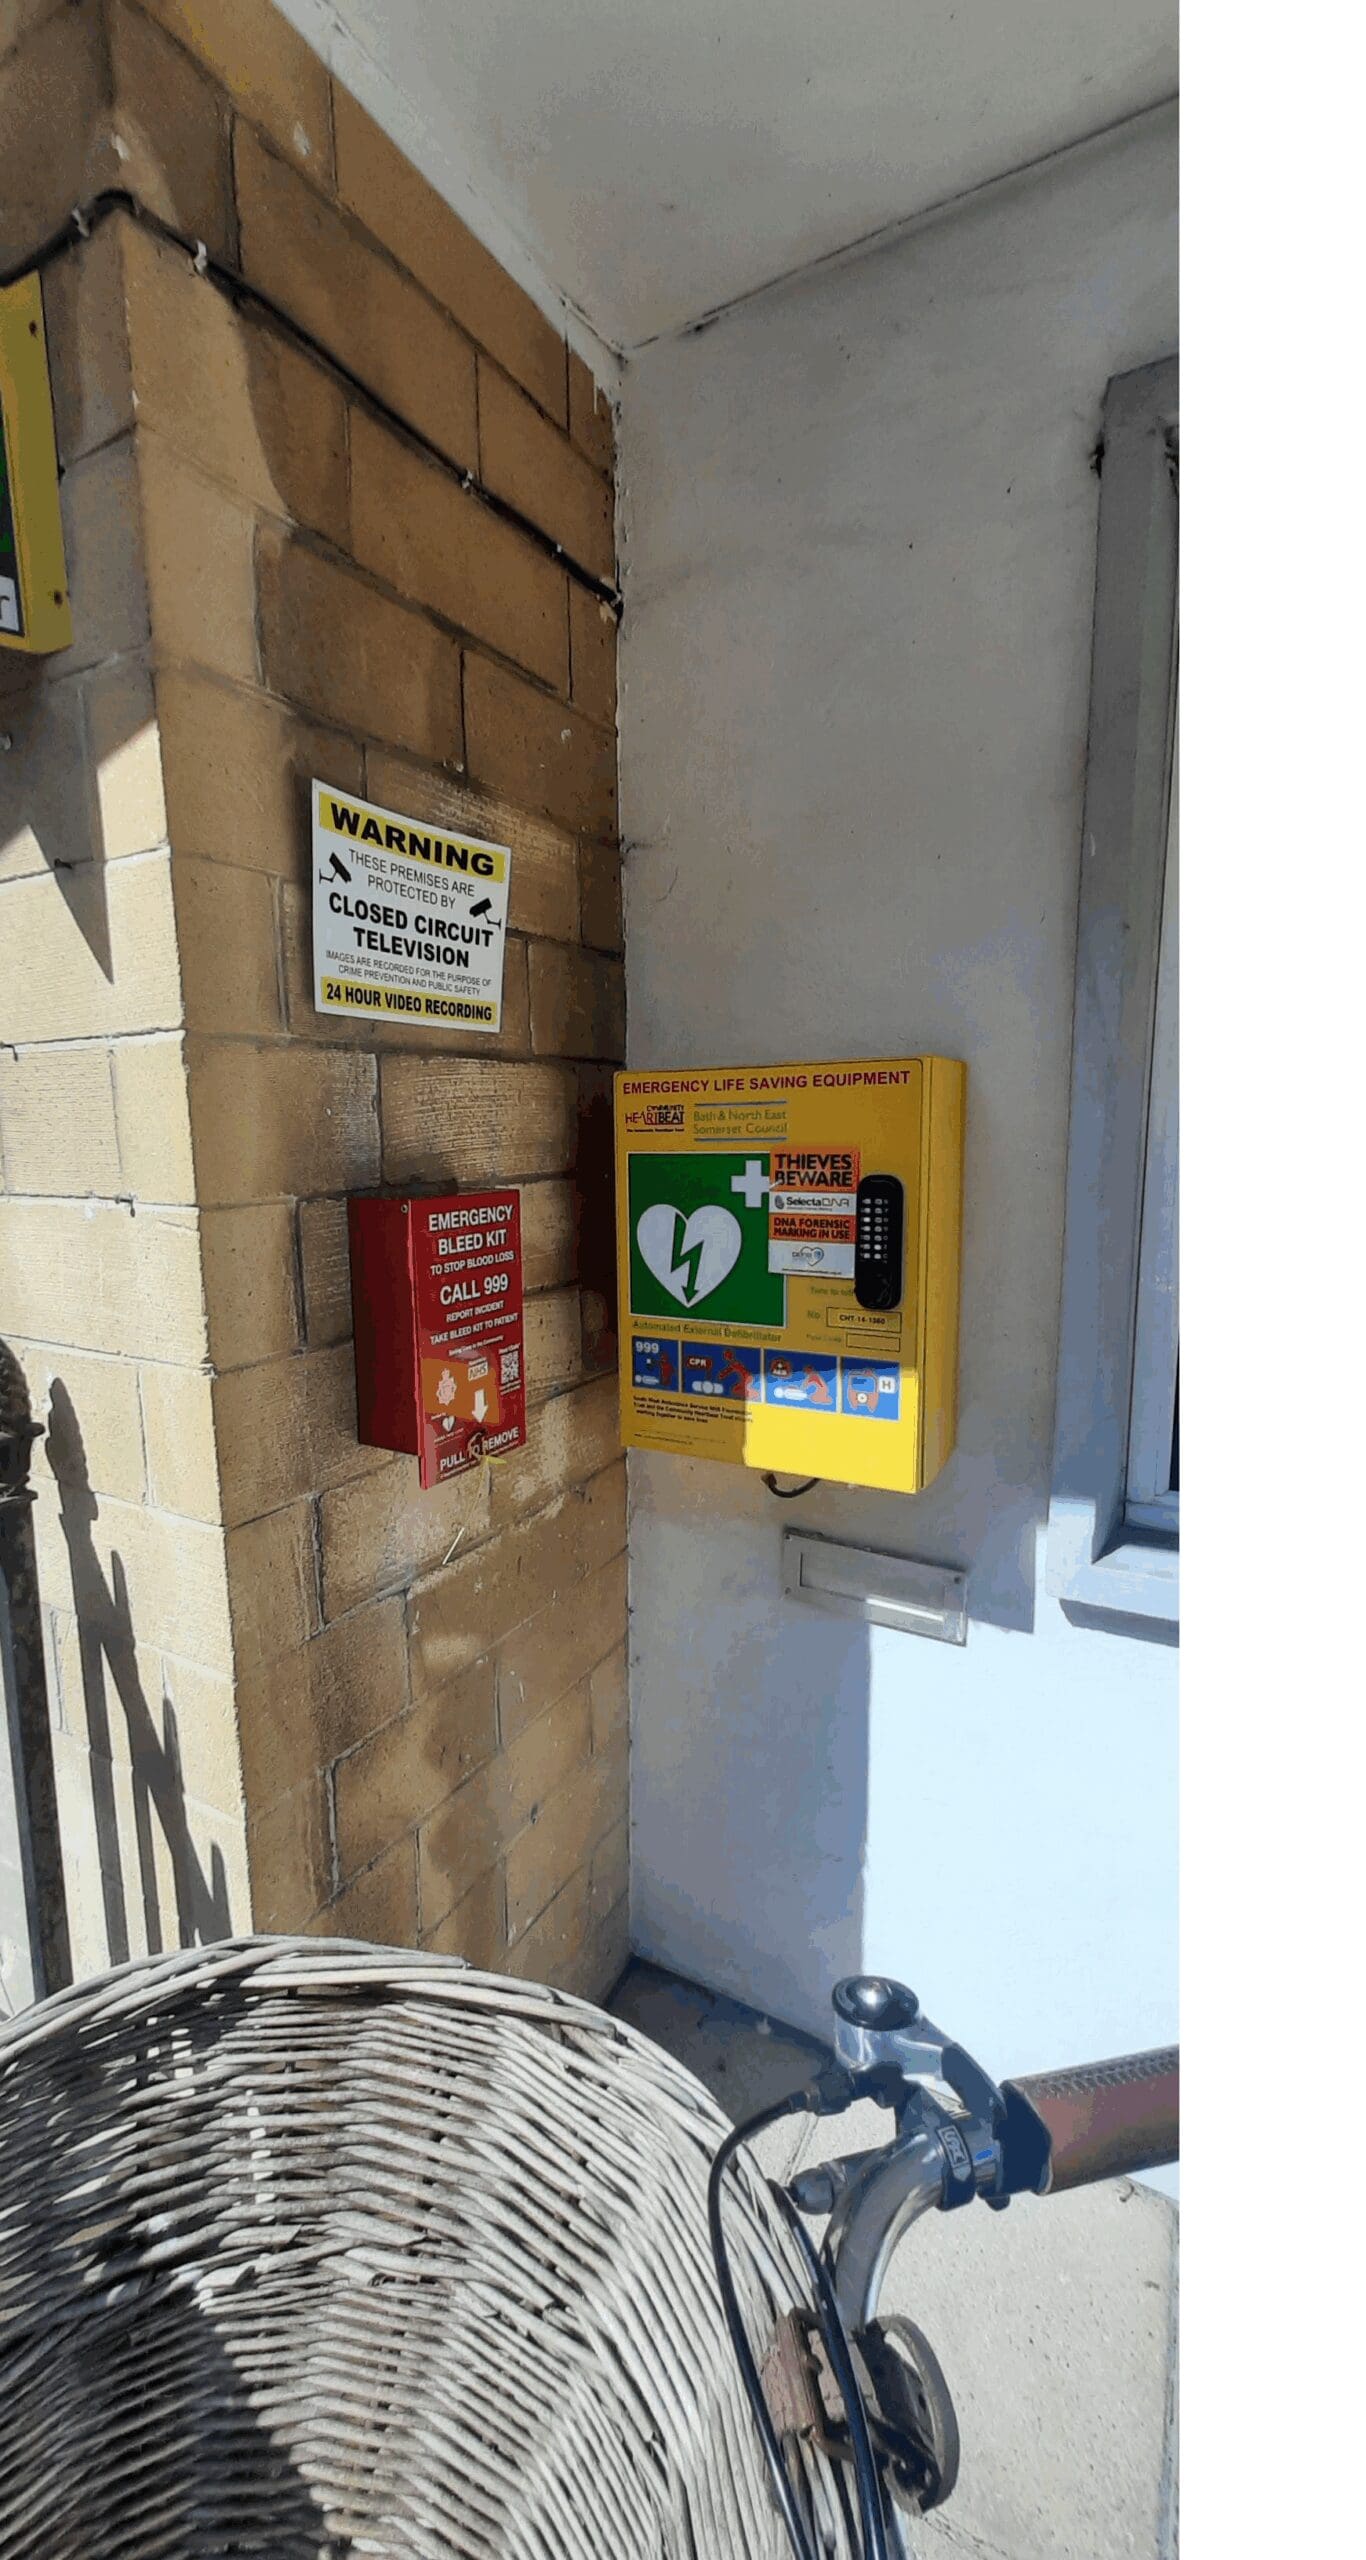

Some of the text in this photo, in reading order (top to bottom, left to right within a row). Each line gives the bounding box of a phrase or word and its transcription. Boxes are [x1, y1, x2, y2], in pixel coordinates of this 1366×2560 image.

[331, 802, 494, 877] WARNING
[349, 849, 475, 897] THESE PREMISES ARE
[368, 875, 456, 909] PROTECTED BY
[329, 892, 494, 947] CLOSED CIRCUIT
[353, 926, 469, 968] TELEVISION
[326, 950, 492, 987] IMAGES ARE RECORDED FOR THE PURPOSE OF
[338, 964, 481, 997] CRIME PREVENTION AND PUBLIC SAFETY
[326, 983, 492, 1021] 24 HOUR VIDEO RECORDING
[623, 1070, 911, 1095] EMERGENCY LIFE SAVING EQUIPMENT
[693, 1109, 787, 1122] Bath & North East
[746, 1122, 788, 1134] Council
[774, 1153, 852, 1170] THIEVES
[774, 1170, 853, 1188] BEWARE
[428, 1205, 513, 1231] EMERGENCY
[773, 1217, 850, 1229] DNA FORENSIC
[438, 1229, 507, 1255] BLEED KIT
[773, 1227, 850, 1240] MARKING IN USE
[430, 1250, 514, 1275] TO STOP BLOOD LOSS
[440, 1273, 508, 1305] CALL 999
[446, 1300, 504, 1323] REPORT INCIDENT
[430, 1312, 519, 1345] TAKE BLEED KIT TO PATIENT
[635, 1341, 659, 1354] 999
[469, 1363, 487, 1379] NHS
[882, 1380, 891, 1390] H
[440, 1451, 465, 1471] PULL
[482, 1427, 519, 1452] REMOVE
